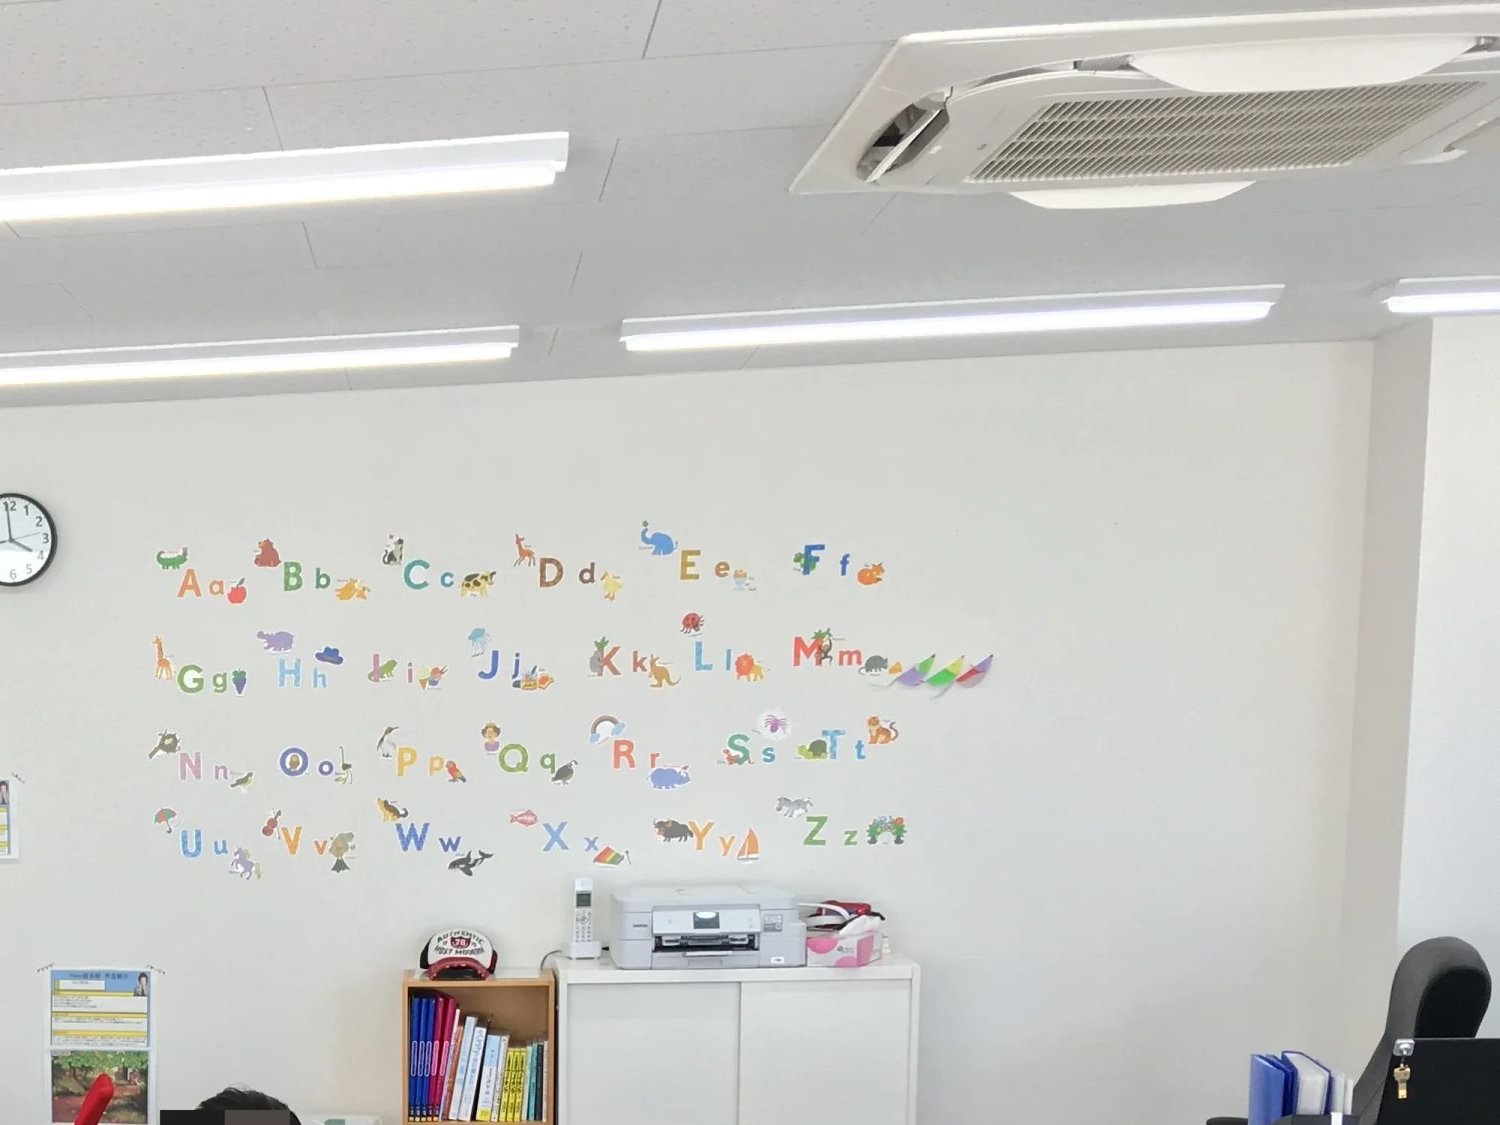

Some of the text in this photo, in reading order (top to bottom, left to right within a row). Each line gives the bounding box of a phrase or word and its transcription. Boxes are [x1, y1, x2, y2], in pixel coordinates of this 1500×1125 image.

[3, 501, 17, 512] 12
[23, 504, 29, 516] 1
[35, 516, 43, 527] 2
[42, 533, 49, 544] 3
[37, 550, 44, 561] 4
[9, 569, 17, 579] 6
[25, 564, 33, 574] 5
[437, 930, 485, 944] AUTHENTIC
